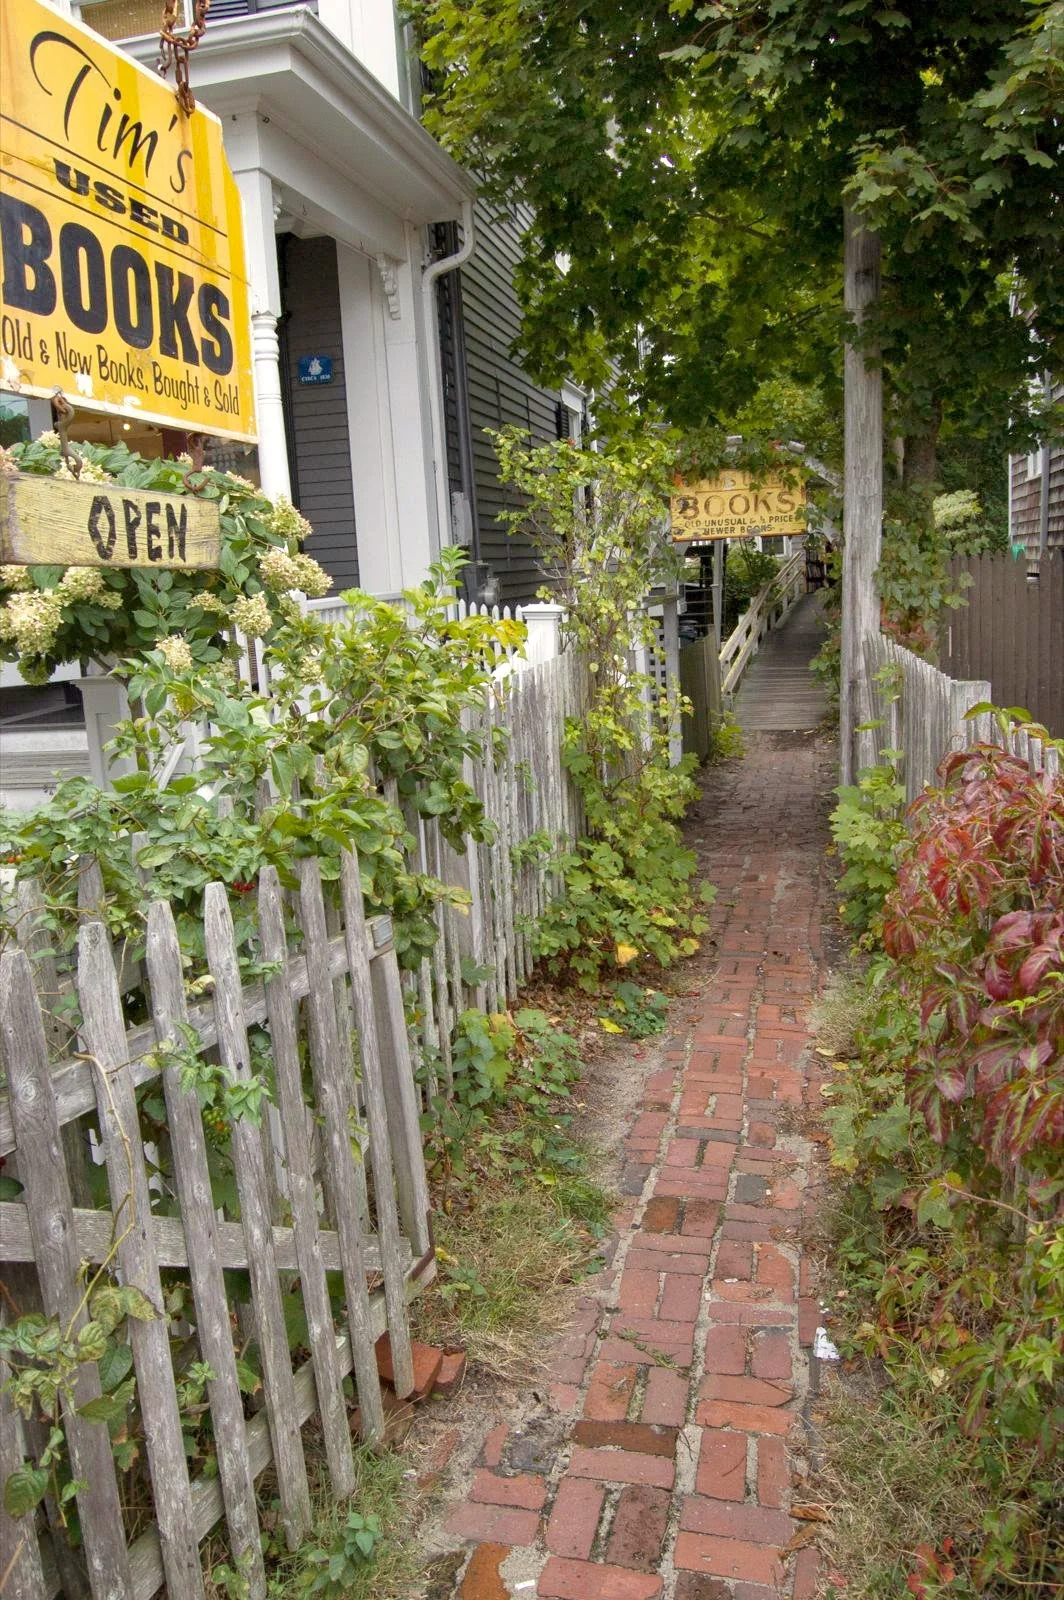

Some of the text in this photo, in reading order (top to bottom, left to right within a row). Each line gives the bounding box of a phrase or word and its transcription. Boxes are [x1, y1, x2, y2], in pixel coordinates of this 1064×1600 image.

[29, 30, 193, 194] Tim's
[52, 157, 190, 246] USED
[0, 191, 234, 377] BOOKS
[2, 315, 33, 361] Old
[39, 338, 50, 365] &
[55, 331, 92, 376] New
[152, 361, 200, 410] Bought
[203, 386, 212, 408] &
[214, 379, 240, 416] Sold
[88, 495, 188, 563] OPEN
[676, 491, 796, 520] BOOKS
[703, 526, 736, 535] NEWER
[704, 517, 747, 527] UNUSUAL
[769, 514, 793, 523] PRICE
